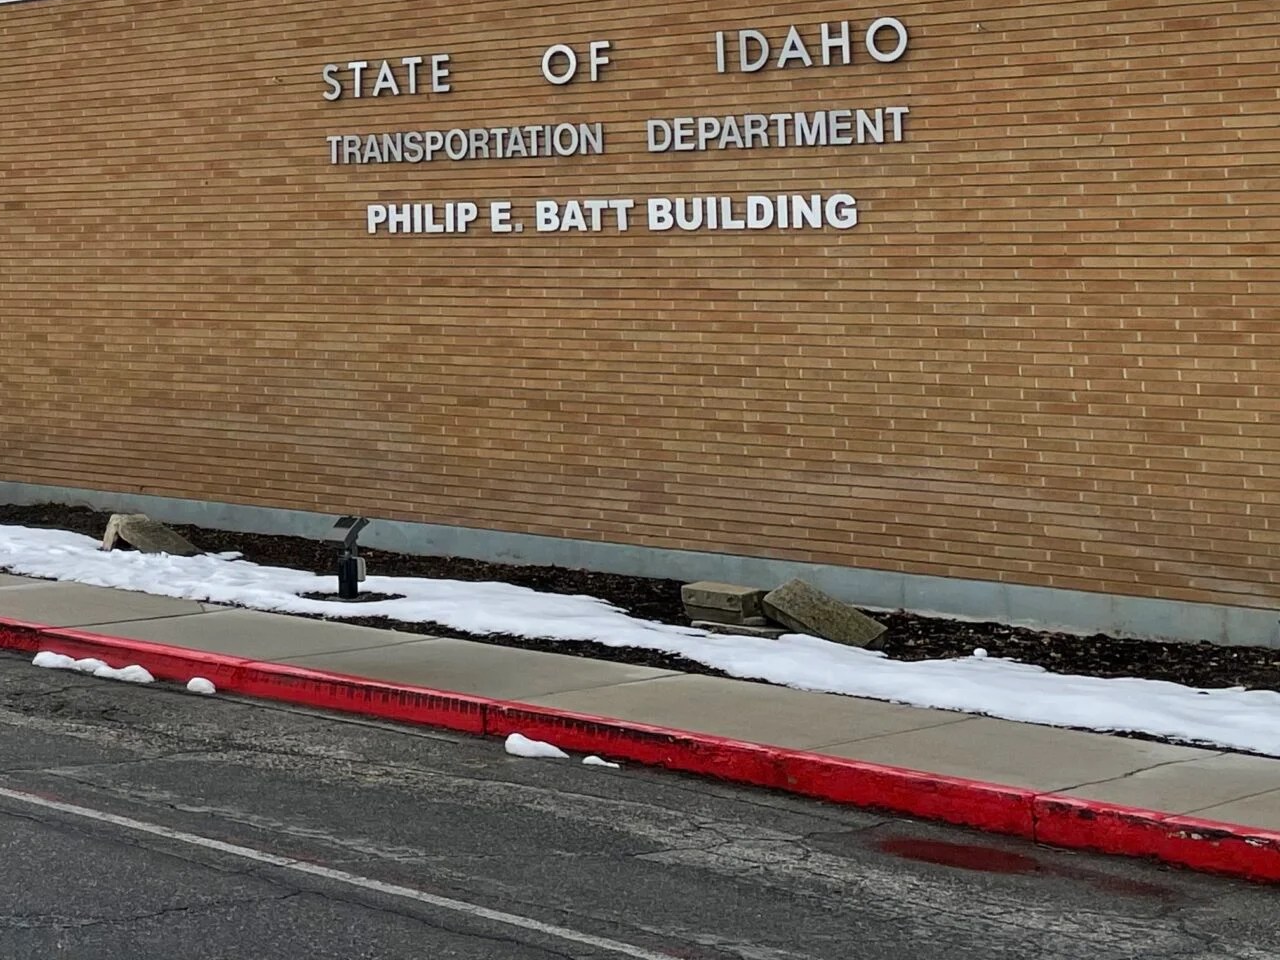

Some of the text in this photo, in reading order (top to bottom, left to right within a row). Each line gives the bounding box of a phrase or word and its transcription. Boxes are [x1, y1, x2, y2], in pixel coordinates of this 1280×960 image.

[323, 17, 908, 101] STATE OF IDAHO
[326, 107, 909, 165] TRANSPORTATION DEPARTMENT
[367, 194, 858, 234] PHILIP E. BATT BUILDING
